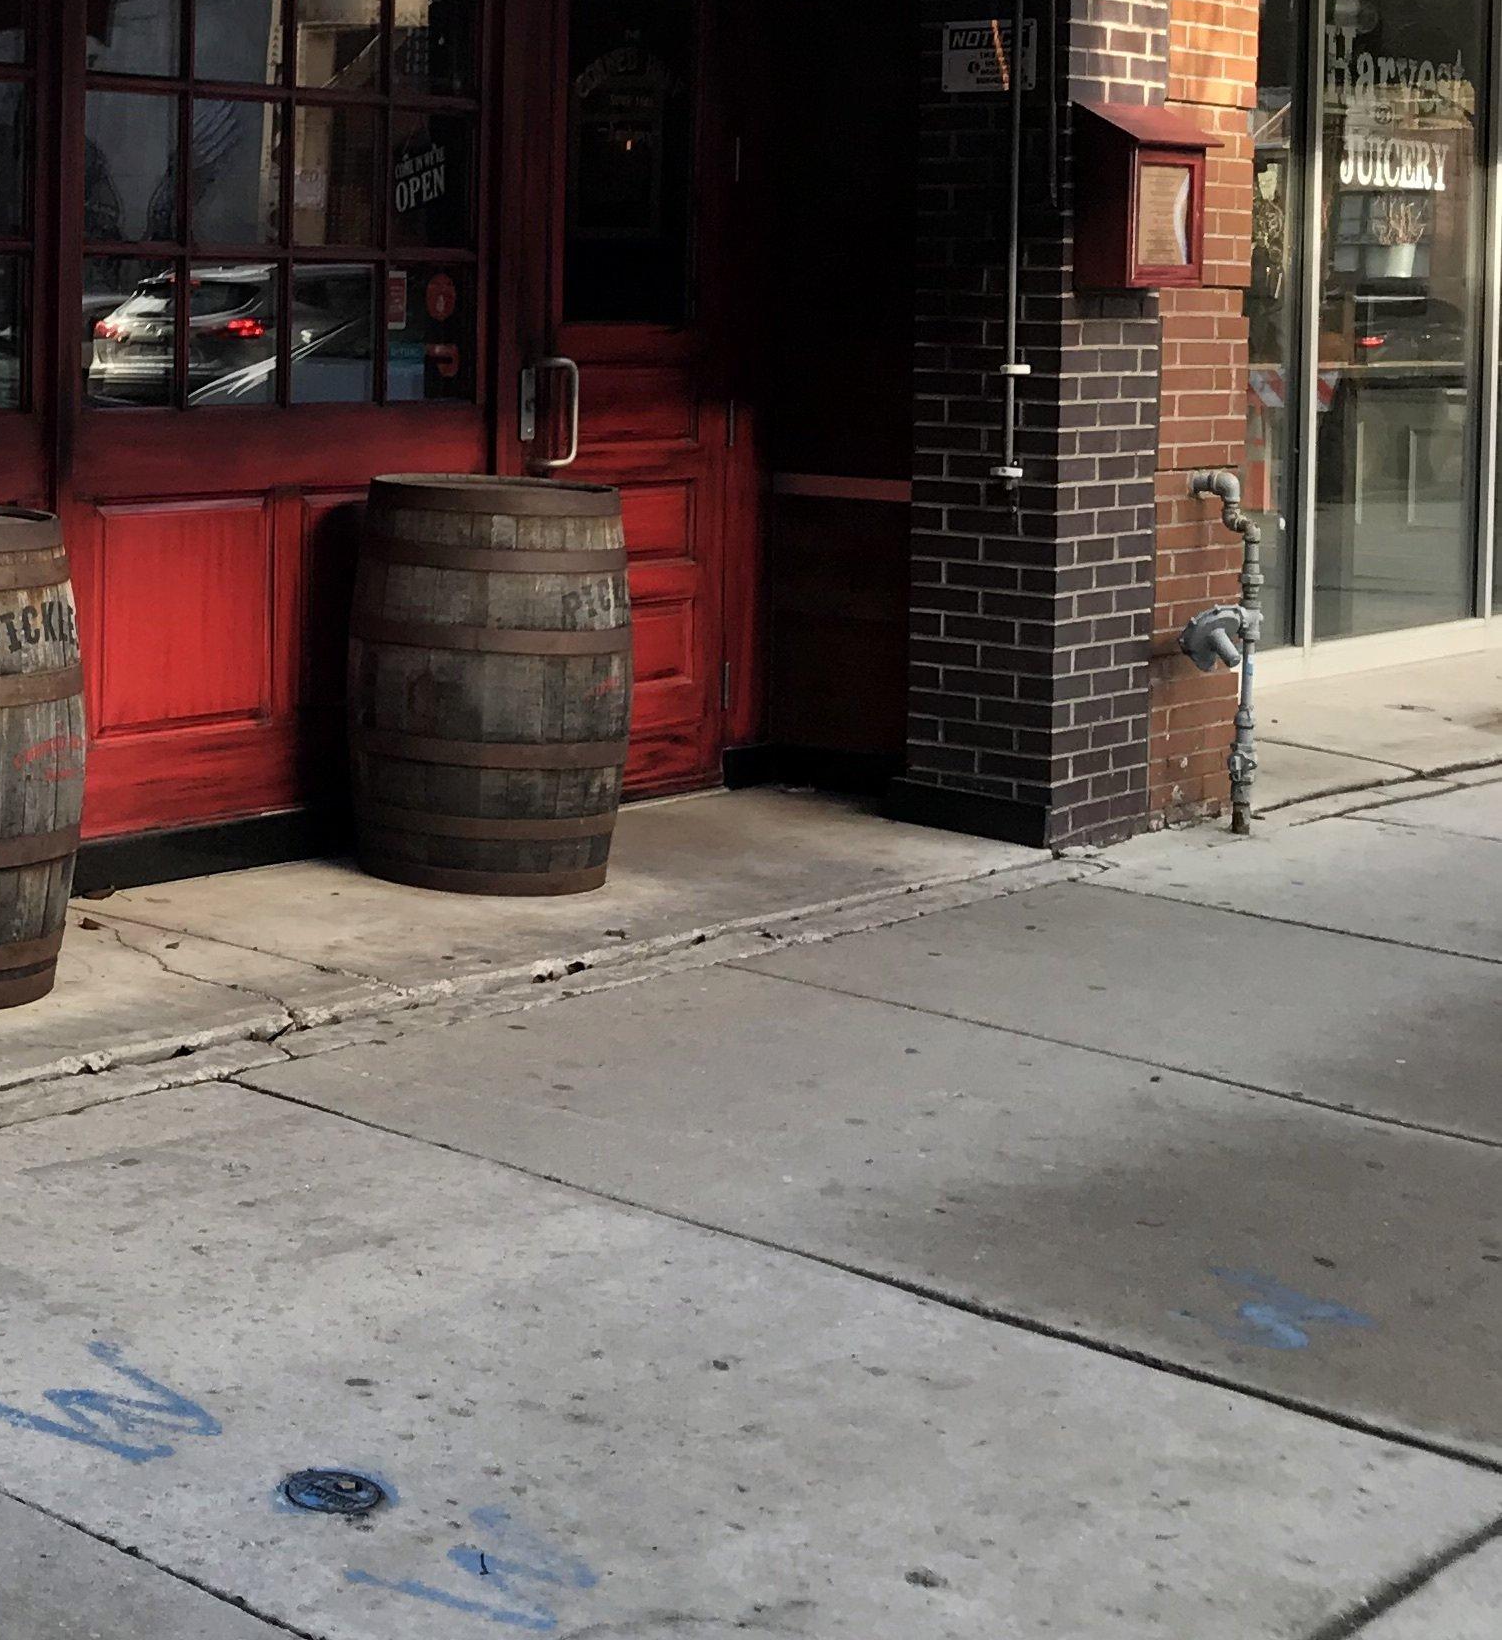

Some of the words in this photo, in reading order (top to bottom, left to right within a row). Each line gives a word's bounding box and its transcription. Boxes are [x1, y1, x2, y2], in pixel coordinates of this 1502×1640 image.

[951, 27, 1029, 50] NOTC
[1325, 24, 1466, 116] Harvest
[395, 164, 446, 213] OPEN
[1339, 135, 1449, 192] JUICERY
